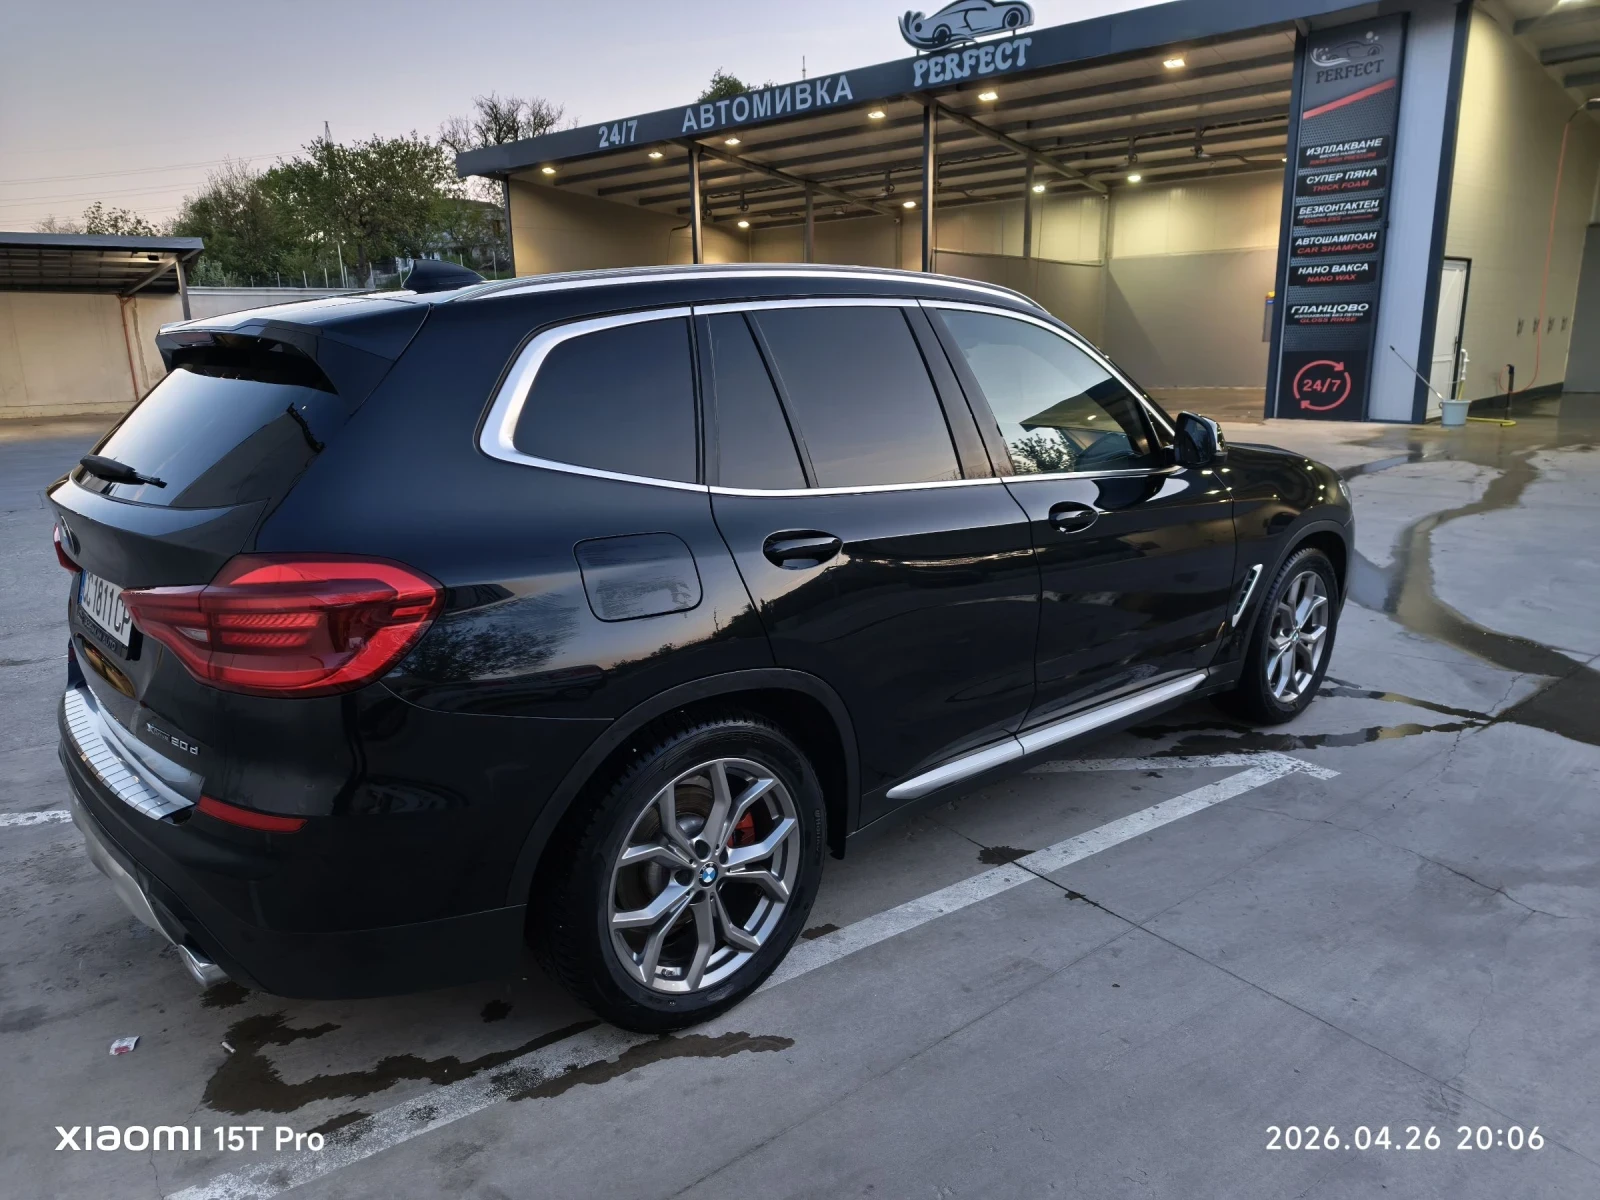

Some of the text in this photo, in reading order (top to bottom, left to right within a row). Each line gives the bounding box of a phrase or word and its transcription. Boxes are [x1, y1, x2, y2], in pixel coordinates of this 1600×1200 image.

[912, 37, 1032, 87] PERFECT
[1316, 59, 1384, 84] PERFECT
[598, 75, 853, 148] 24/7 АВТОМИВКА
[1306, 138, 1383, 156] ИЗПЛАКВАНЕ
[1306, 168, 1378, 185] СУПЕР ПЯНА
[1313, 180, 1369, 192] THICK FOAM
[1299, 199, 1380, 215] БЕЗКОНТАКТЕН
[1295, 232, 1377, 246] АВТОШАМПОАН
[1320, 242, 1374, 253] SHAMPOO
[1298, 263, 1369, 275] НАНО ВАКСА
[1291, 303, 1369, 314] ГЛАНЦОВО
[1302, 379, 1342, 393] 24/7
